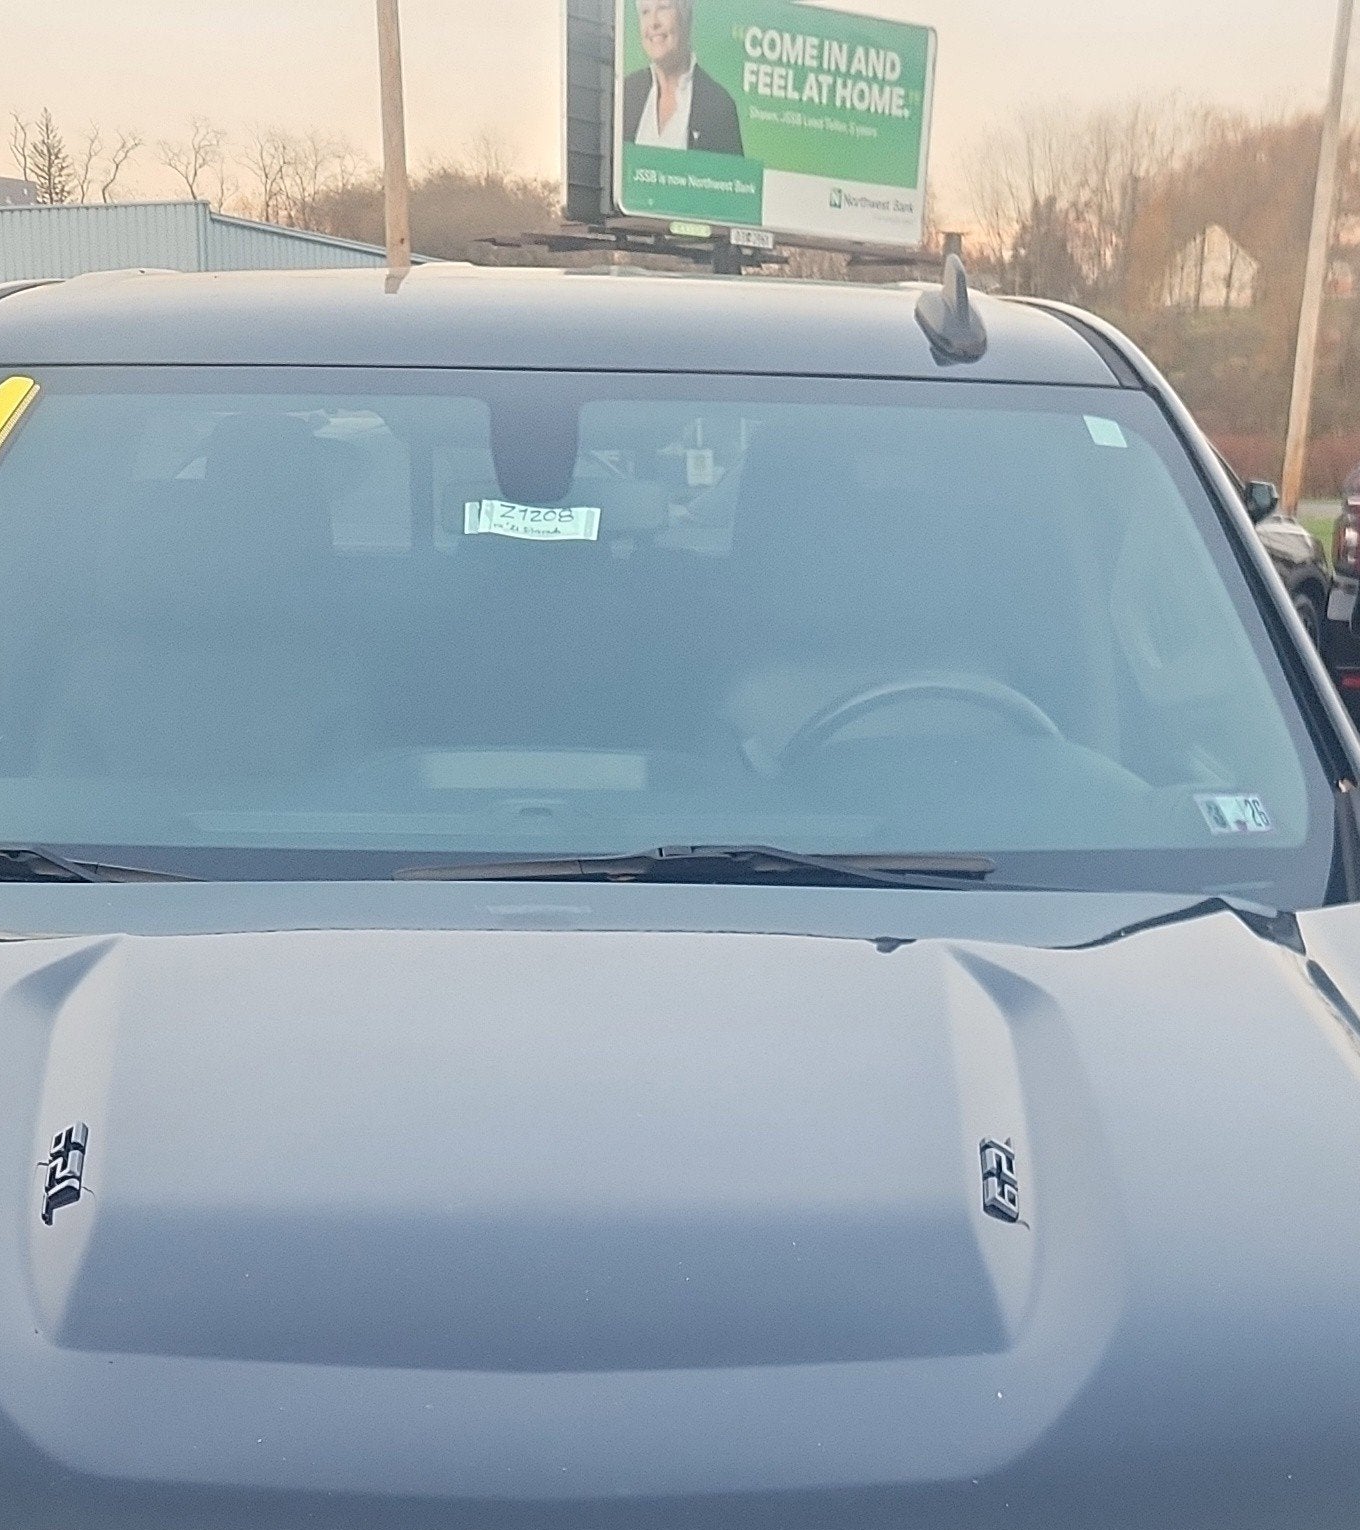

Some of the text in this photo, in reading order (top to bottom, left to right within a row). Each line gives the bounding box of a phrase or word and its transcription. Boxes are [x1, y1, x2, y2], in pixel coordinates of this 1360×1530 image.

[743, 25, 901, 82] COME IN AND
[743, 61, 800, 100] FEEL
[801, 71, 833, 105] AT
[843, 193, 890, 210] Northwest
[893, 198, 914, 214] Bank
[1244, 798, 1271, 827] 26
